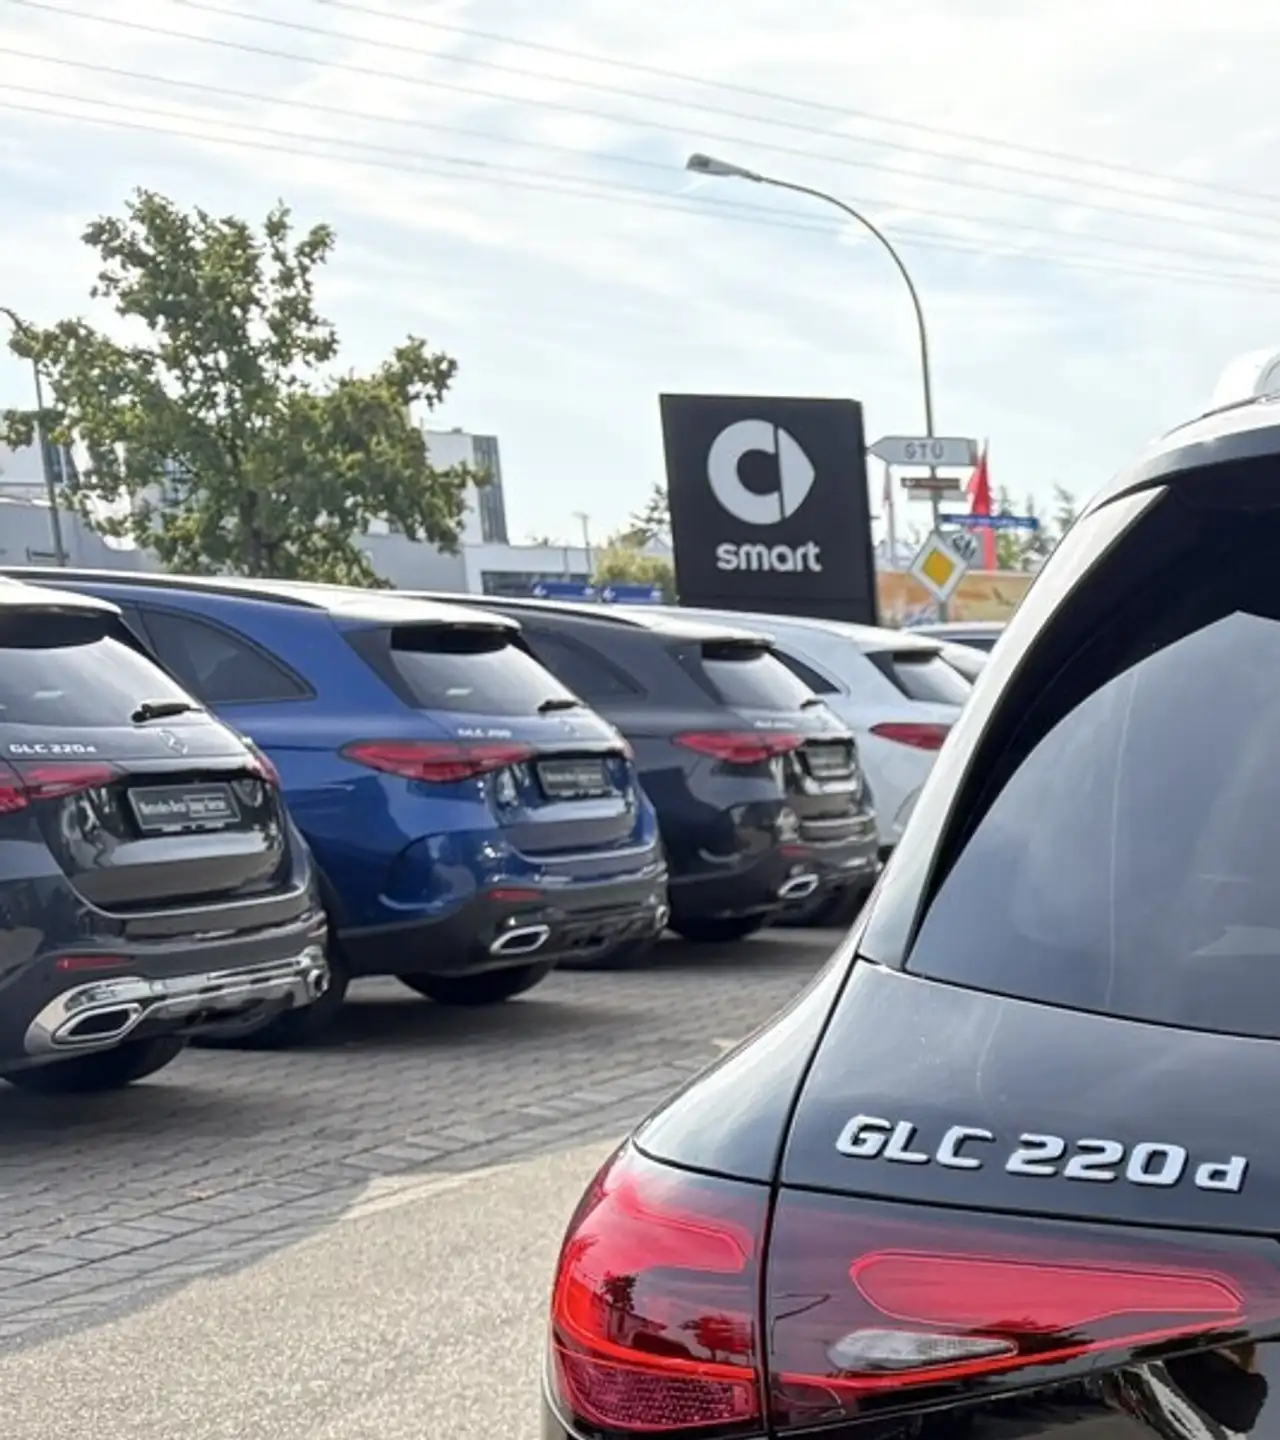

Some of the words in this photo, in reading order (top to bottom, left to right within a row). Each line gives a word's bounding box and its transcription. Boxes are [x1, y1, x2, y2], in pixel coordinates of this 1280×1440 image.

[716, 541, 822, 574] smart
[9, 743, 48, 753] GLC
[835, 1114, 994, 1168] GLC
[1005, 1132, 1248, 1192] 220d
